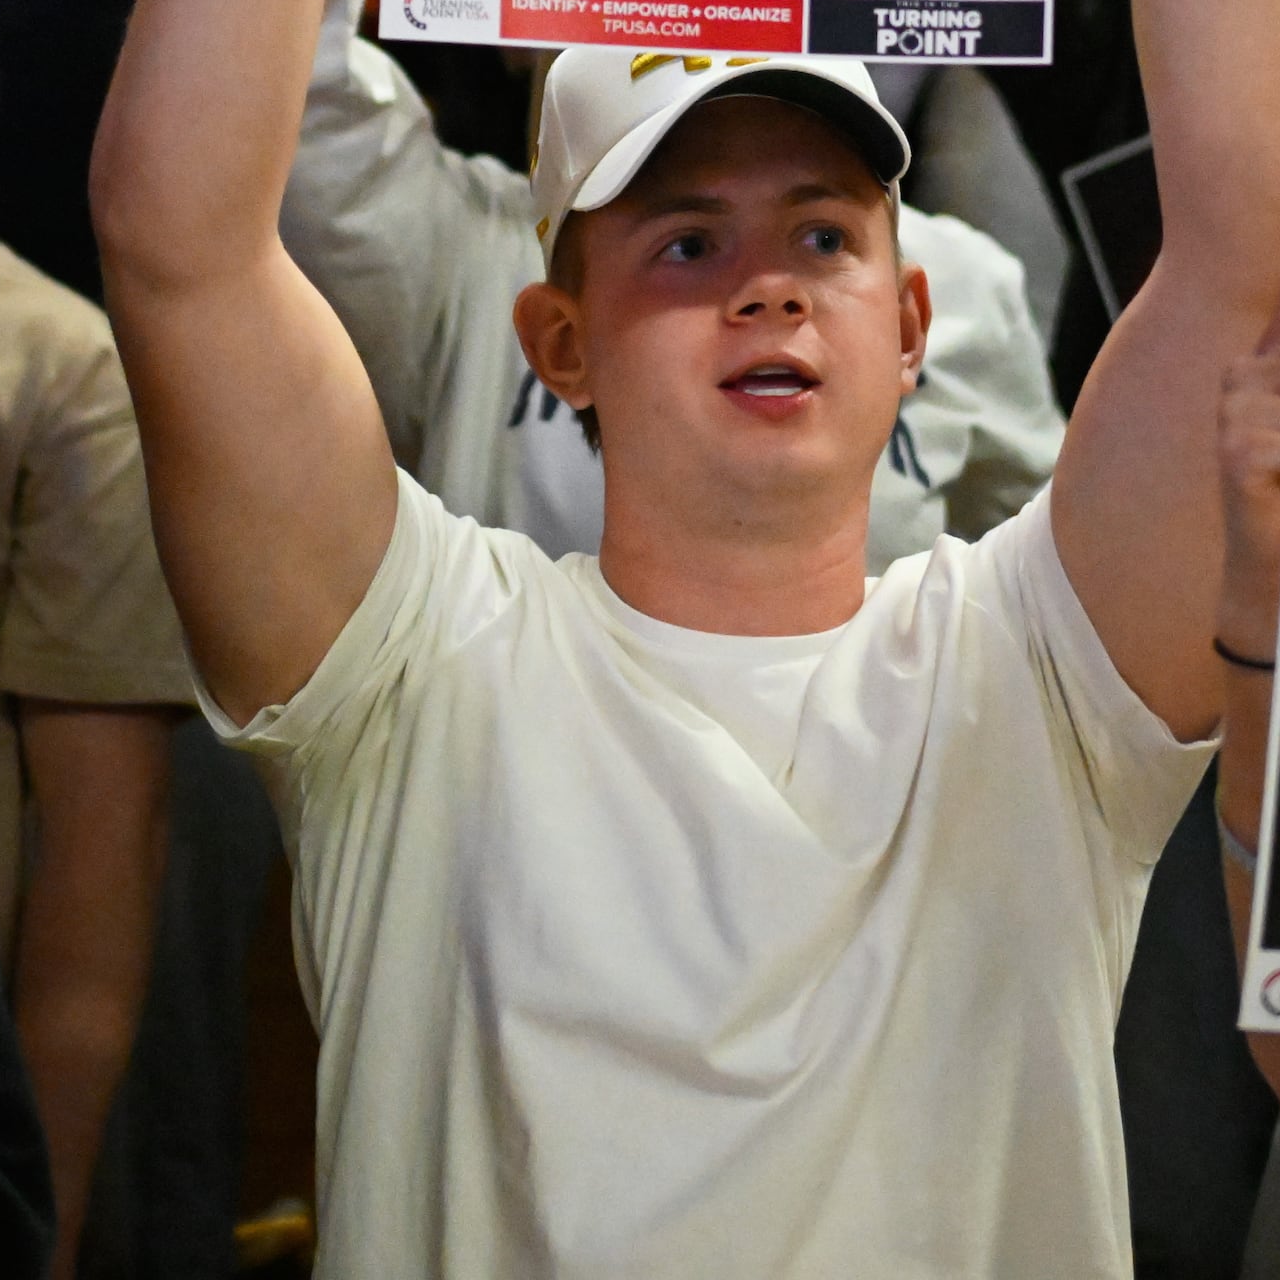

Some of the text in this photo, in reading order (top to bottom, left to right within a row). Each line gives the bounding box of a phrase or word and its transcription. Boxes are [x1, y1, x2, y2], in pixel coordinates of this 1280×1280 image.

[422, 7, 489, 21] POINT USA
[602, 1, 689, 18] EMPOWER
[704, 5, 793, 24] ORGANIZE
[873, 8, 983, 29] TURNING
[602, 18, 701, 37] TPUSA.COM
[876, 28, 983, 56] POINT
